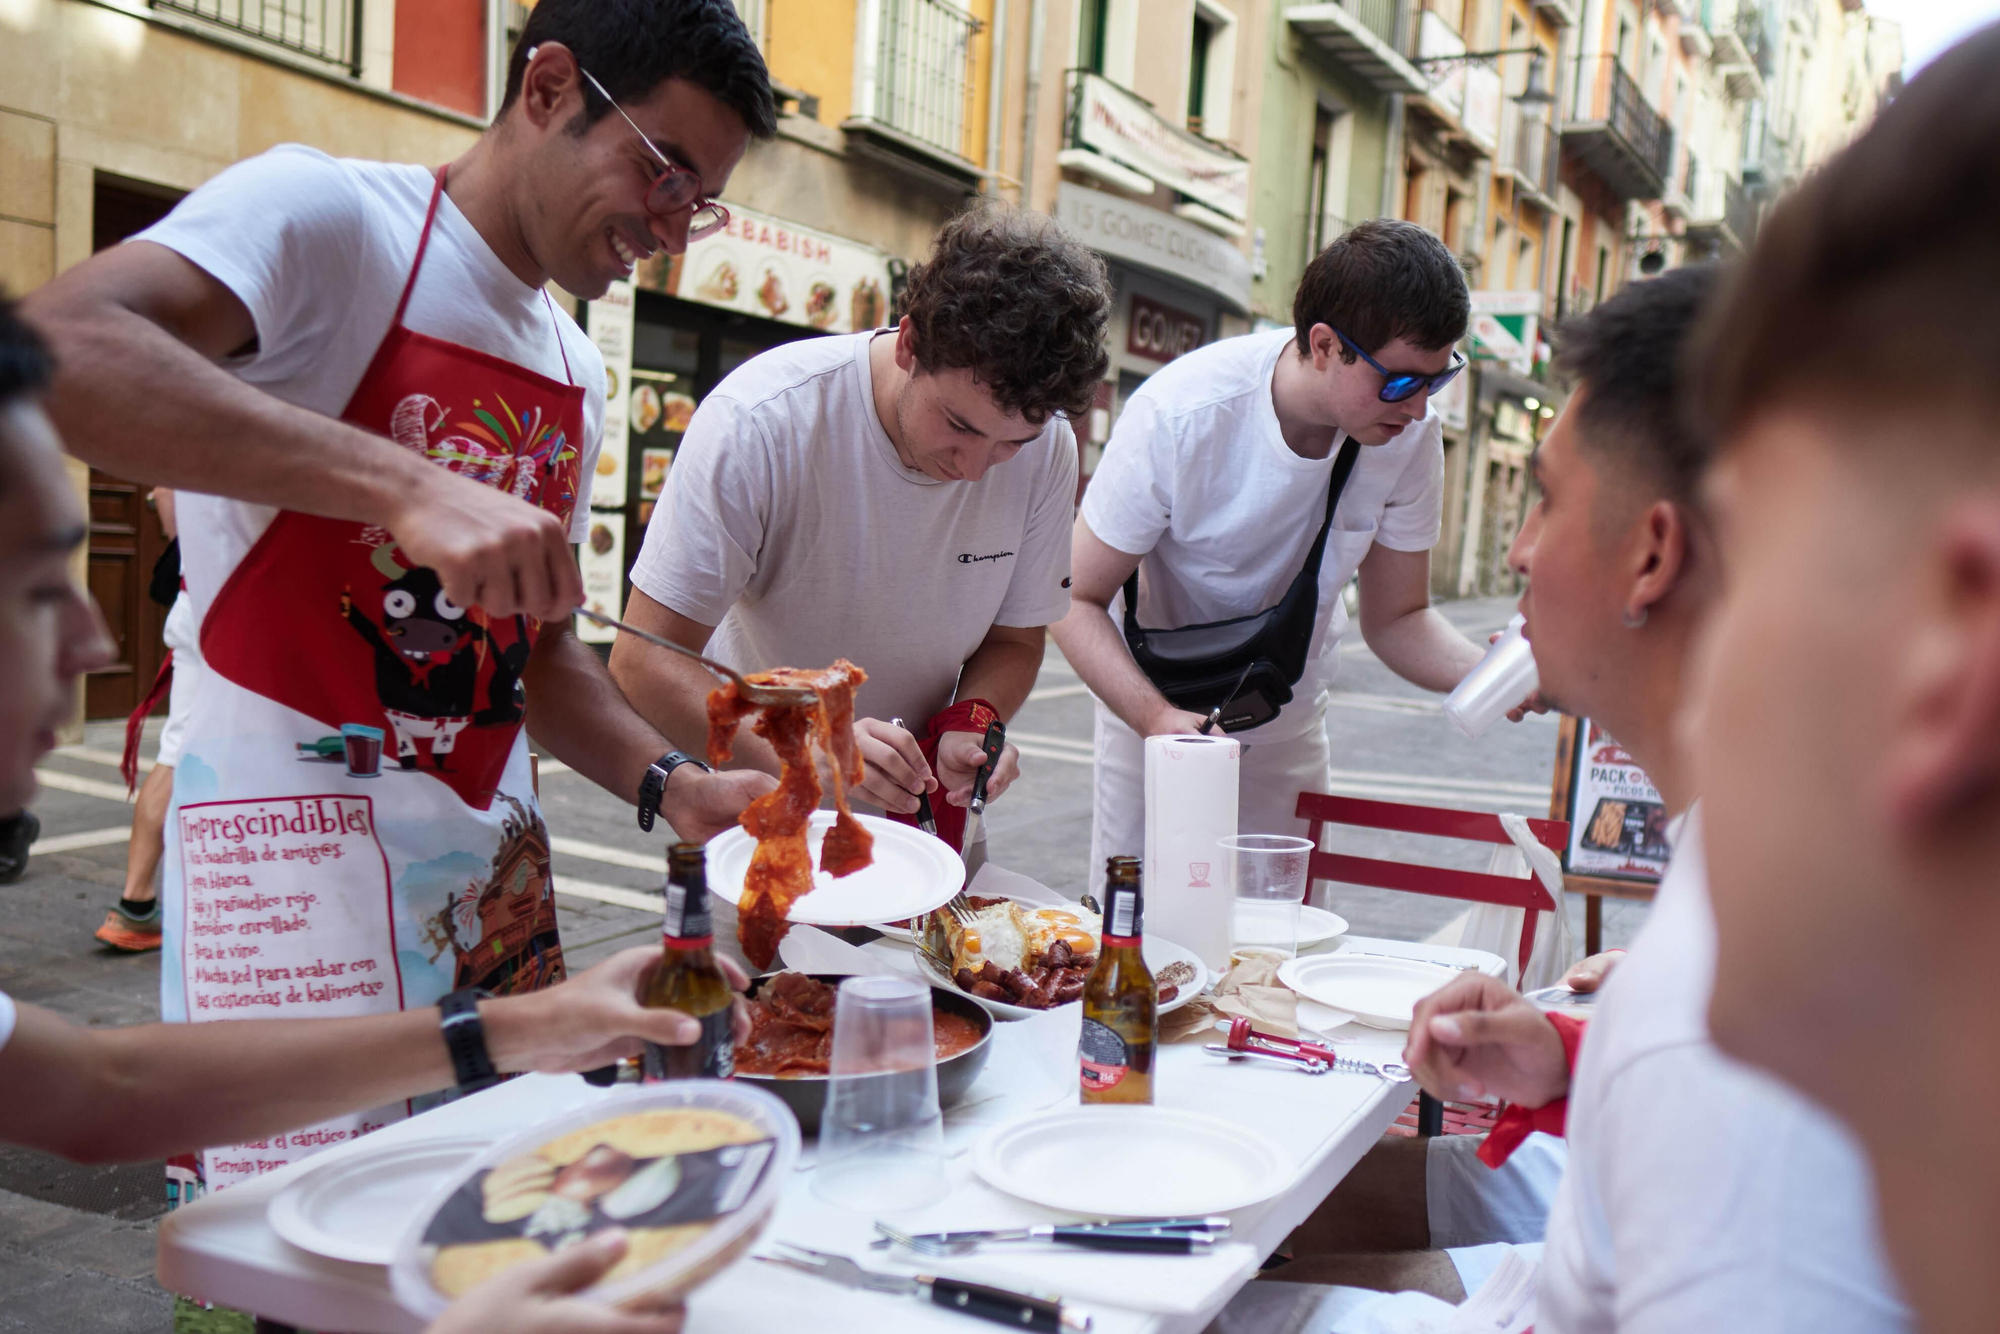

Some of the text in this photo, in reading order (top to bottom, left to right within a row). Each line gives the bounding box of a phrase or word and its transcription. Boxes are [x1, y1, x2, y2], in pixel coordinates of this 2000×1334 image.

[725, 214, 832, 265] EBABISH
[957, 550, 1015, 564] Champion
[1590, 767, 1628, 785] PACK
[1612, 784, 1644, 797] PICOS
[182, 799, 369, 853] Imprescindibles
[261, 843, 278, 861] de
[255, 967, 292, 988] para
[294, 958, 346, 978] acabar
[350, 958, 377, 973] con
[286, 985, 303, 1003] de
[305, 980, 384, 1003] kalimotxo
[290, 1129, 347, 1147] cántico
